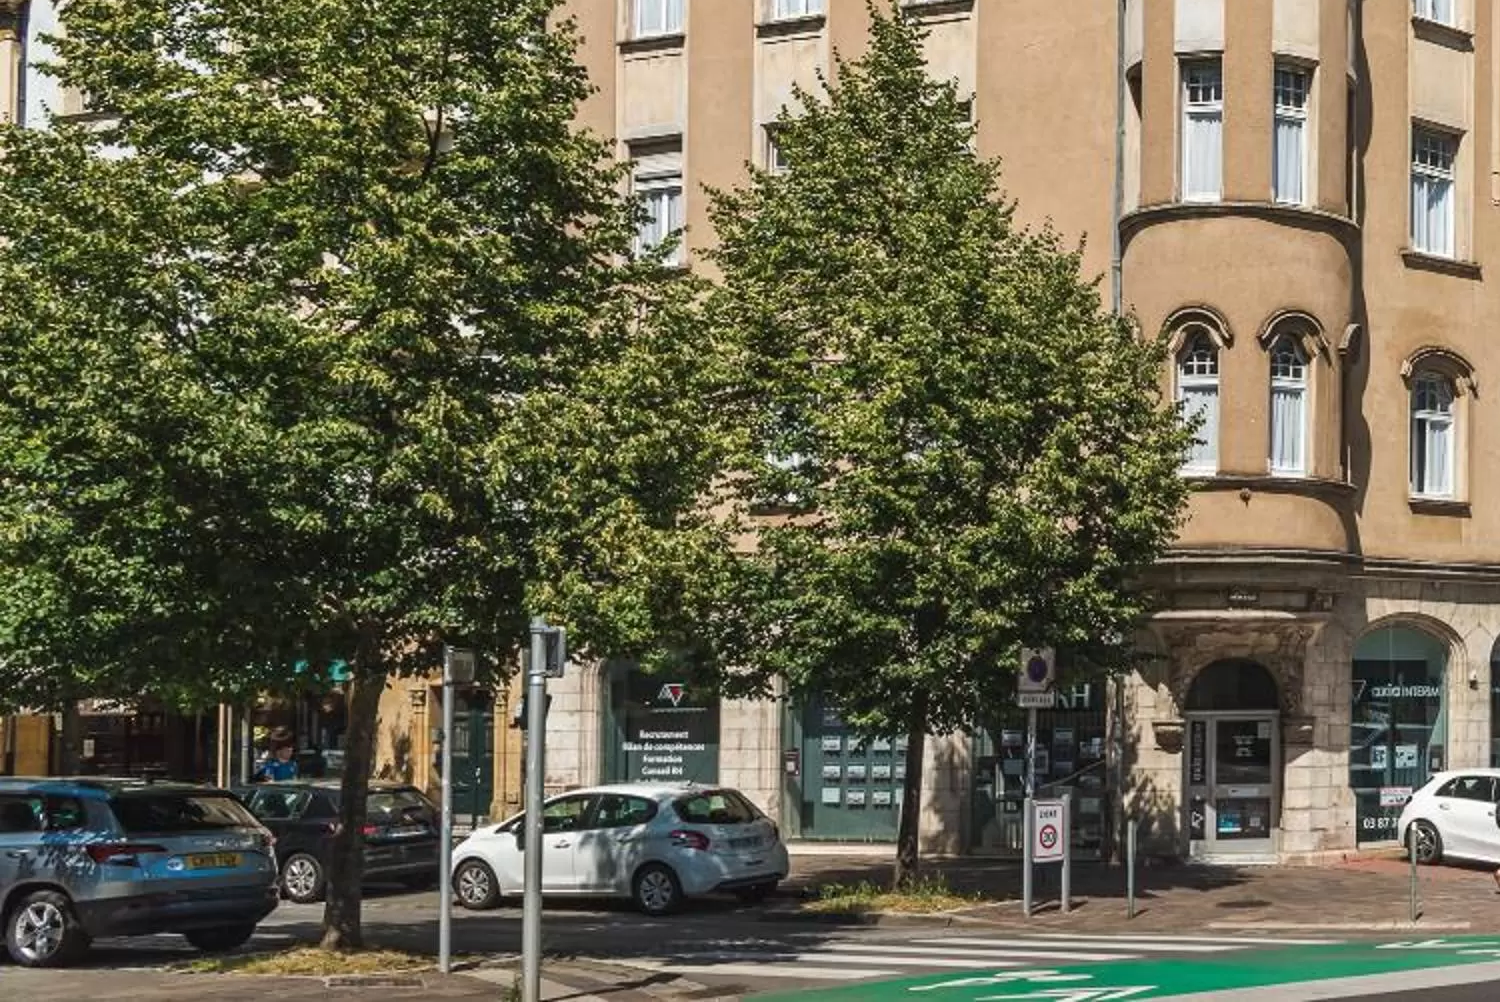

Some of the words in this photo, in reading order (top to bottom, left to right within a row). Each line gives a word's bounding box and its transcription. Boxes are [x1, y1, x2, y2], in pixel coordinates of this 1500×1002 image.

[640, 729, 688, 739] Recrutement
[643, 754, 683, 763] Formation
[1039, 809, 1057, 818] ZONE
[1363, 818, 1376, 829] 03
[1377, 818, 1389, 829] 87
